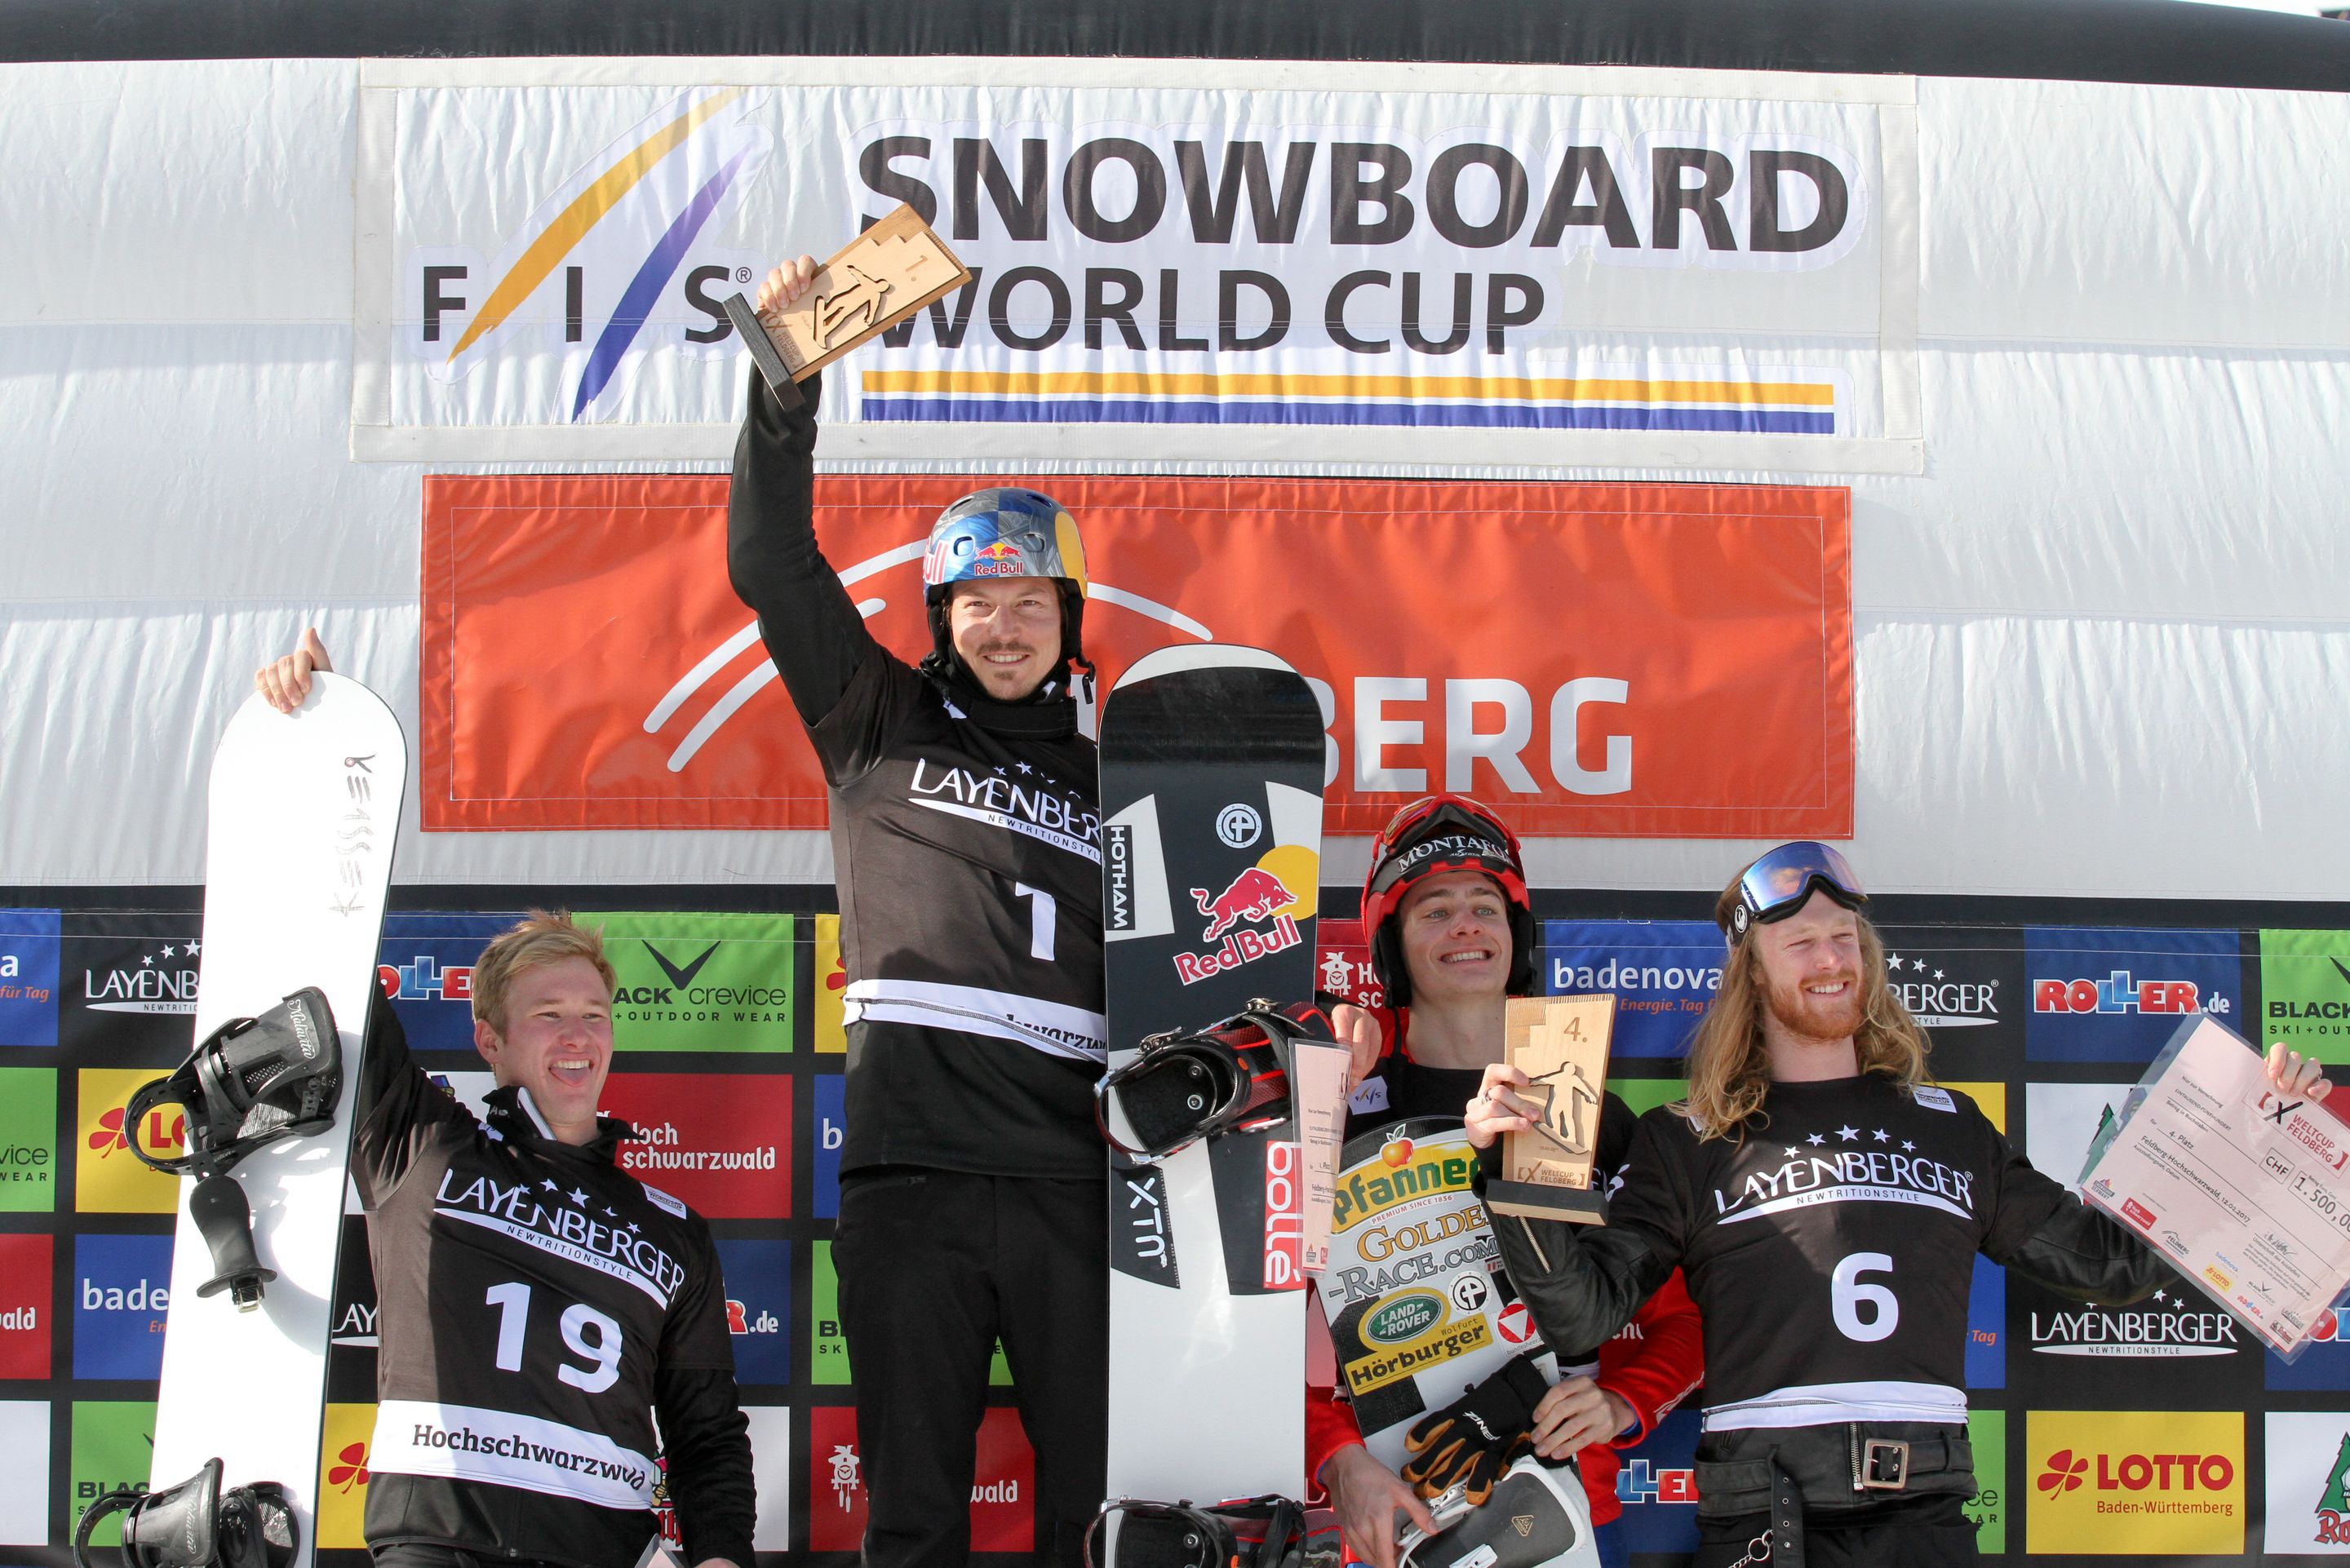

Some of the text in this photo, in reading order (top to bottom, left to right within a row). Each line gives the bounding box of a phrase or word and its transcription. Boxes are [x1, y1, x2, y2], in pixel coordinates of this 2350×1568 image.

[858, 135, 1849, 254] SNOWBOARD
[881, 265, 1545, 355] WORLD CUP
[775, 333, 796, 365] FELDBERG
[781, 331, 800, 357] WELTCUP
[975, 562, 1023, 576] Red Bull
[1111, 826, 1128, 928] HOTHAM
[1173, 913, 1302, 986] Red Bull
[1554, 959, 1723, 990] badenova
[24, 987, 50, 1003] Tag
[689, 986, 787, 1007] crevice
[1679, 999, 1704, 1016] Tag
[734, 1012, 787, 1023] WEAR
[1563, 1017, 1588, 1043] 4.
[2177, 1134, 2194, 1150] Platz
[2286, 1124, 2334, 1163] FELDBERG
[2292, 1114, 2335, 1149] WELTCUP
[623, 1146, 775, 1171] schwarzwald
[2266, 1155, 2289, 1177] CHF
[1540, 1176, 1576, 1185] FELDBERG
[1541, 1169, 1574, 1178] WELTCUP
[1797, 1188, 1920, 1205] NEWTRITIONSTYLE
[1372, 1195, 1452, 1225] PREMIUM SINCE 1856
[2220, 1196, 2250, 1224] 12.02.2017
[508, 1225, 633, 1281] NEWTRITIONSTYLE
[2167, 1234, 2190, 1255] FELDBERG
[2212, 1271, 2230, 1287] LOTTO
[1831, 1251, 1900, 1342] 6
[486, 1282, 623, 1393] 19
[1440, 1318, 1479, 1336] Wolfurt
[1972, 1330, 1997, 1346] Tag
[2032, 1311, 2238, 1343] LAYENBERGER
[1351, 1323, 1484, 1387] Hörburger
[2088, 1346, 2181, 1355] NEWTRITIONSTYLE
[2097, 1454, 2234, 1491] LOTTO
[2096, 1499, 2233, 1517] Baden-Württemberg
